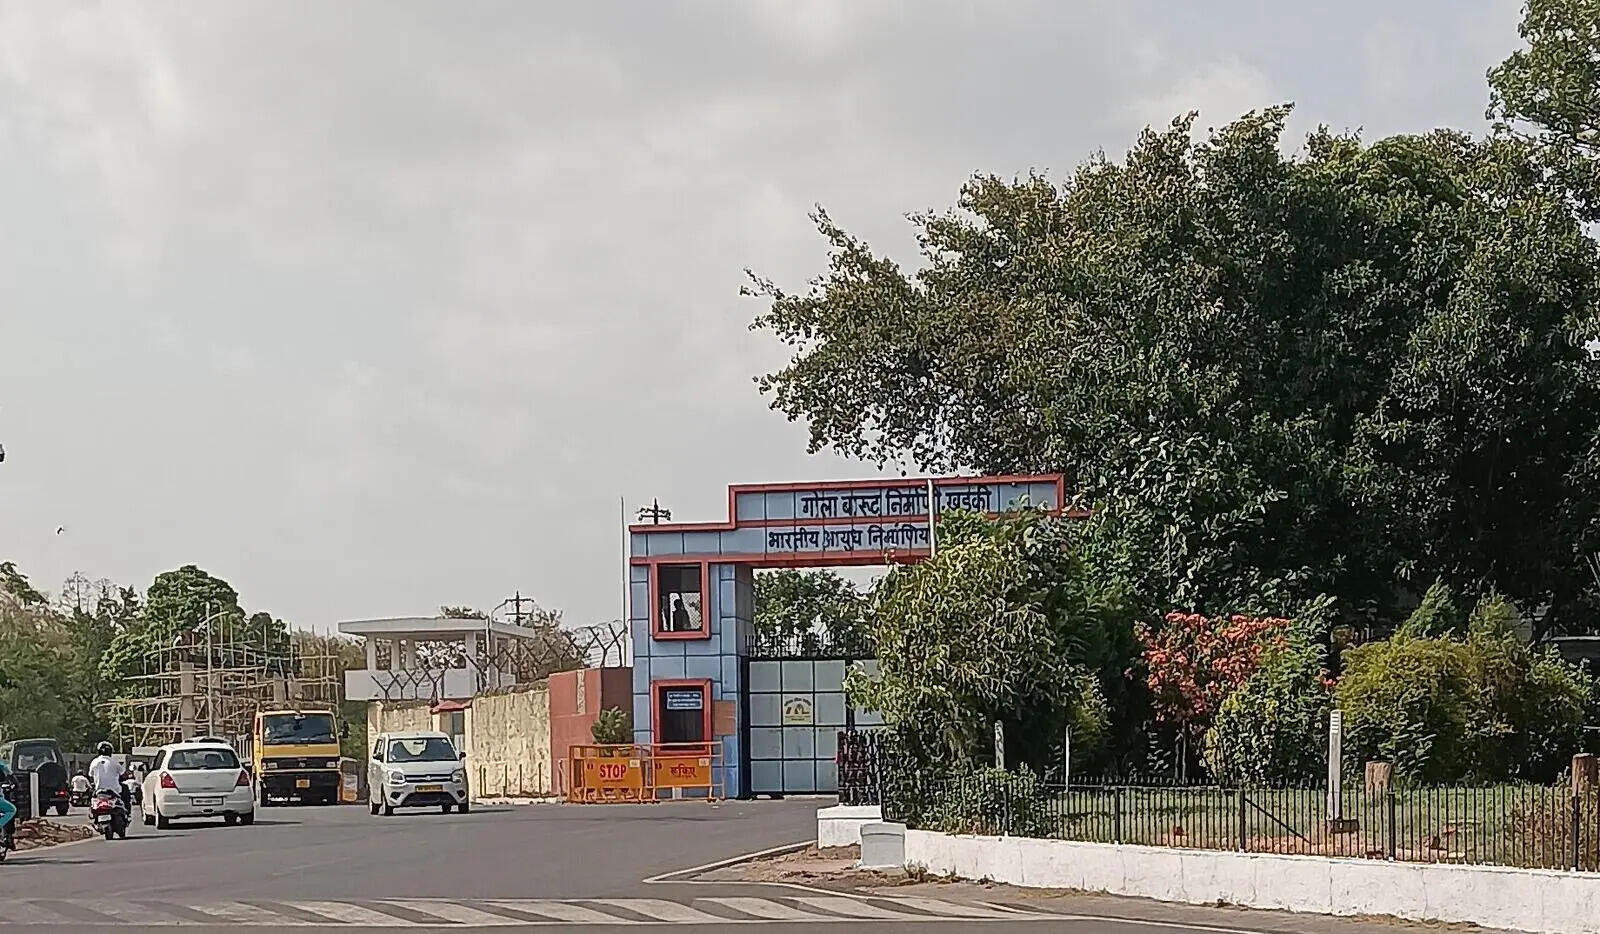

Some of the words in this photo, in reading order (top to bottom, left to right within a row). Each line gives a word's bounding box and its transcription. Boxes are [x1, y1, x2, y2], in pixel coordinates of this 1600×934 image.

[801, 491, 838, 517] गोला
[768, 527, 820, 550] भारतीय
[823, 529, 863, 552] आयुध
[868, 523, 931, 546] निर्माणिय
[600, 764, 627, 778] STOP
